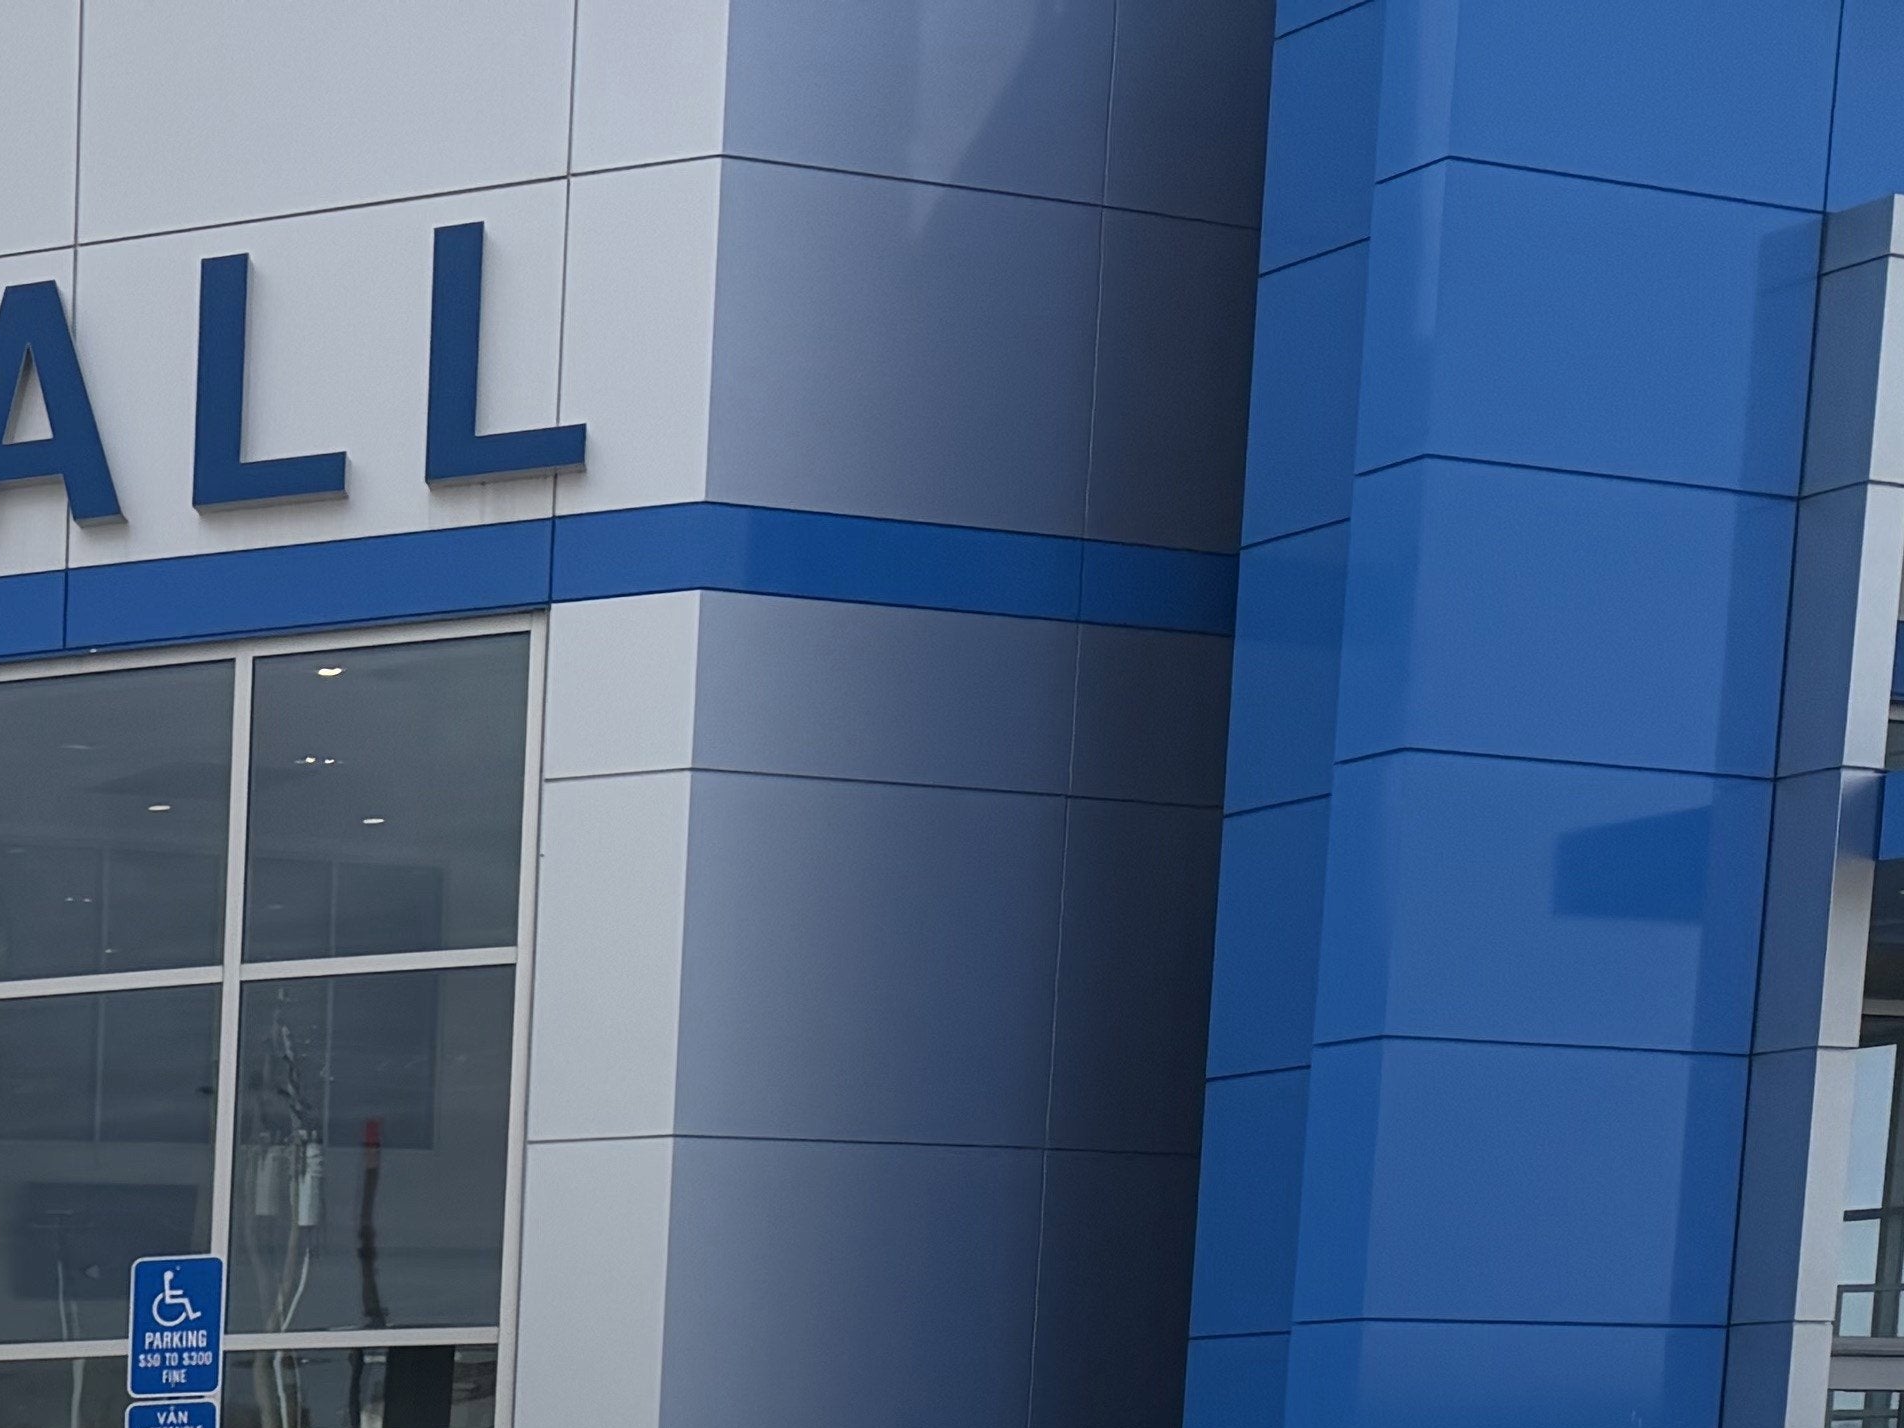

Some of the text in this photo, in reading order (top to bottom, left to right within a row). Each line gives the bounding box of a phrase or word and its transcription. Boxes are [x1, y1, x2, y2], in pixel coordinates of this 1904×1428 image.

[145, 1330, 207, 1349] PARKING
[138, 1351, 213, 1368] $50 TO $300
[162, 1368, 188, 1384] FINE
[157, 1411, 188, 1425] VAN
